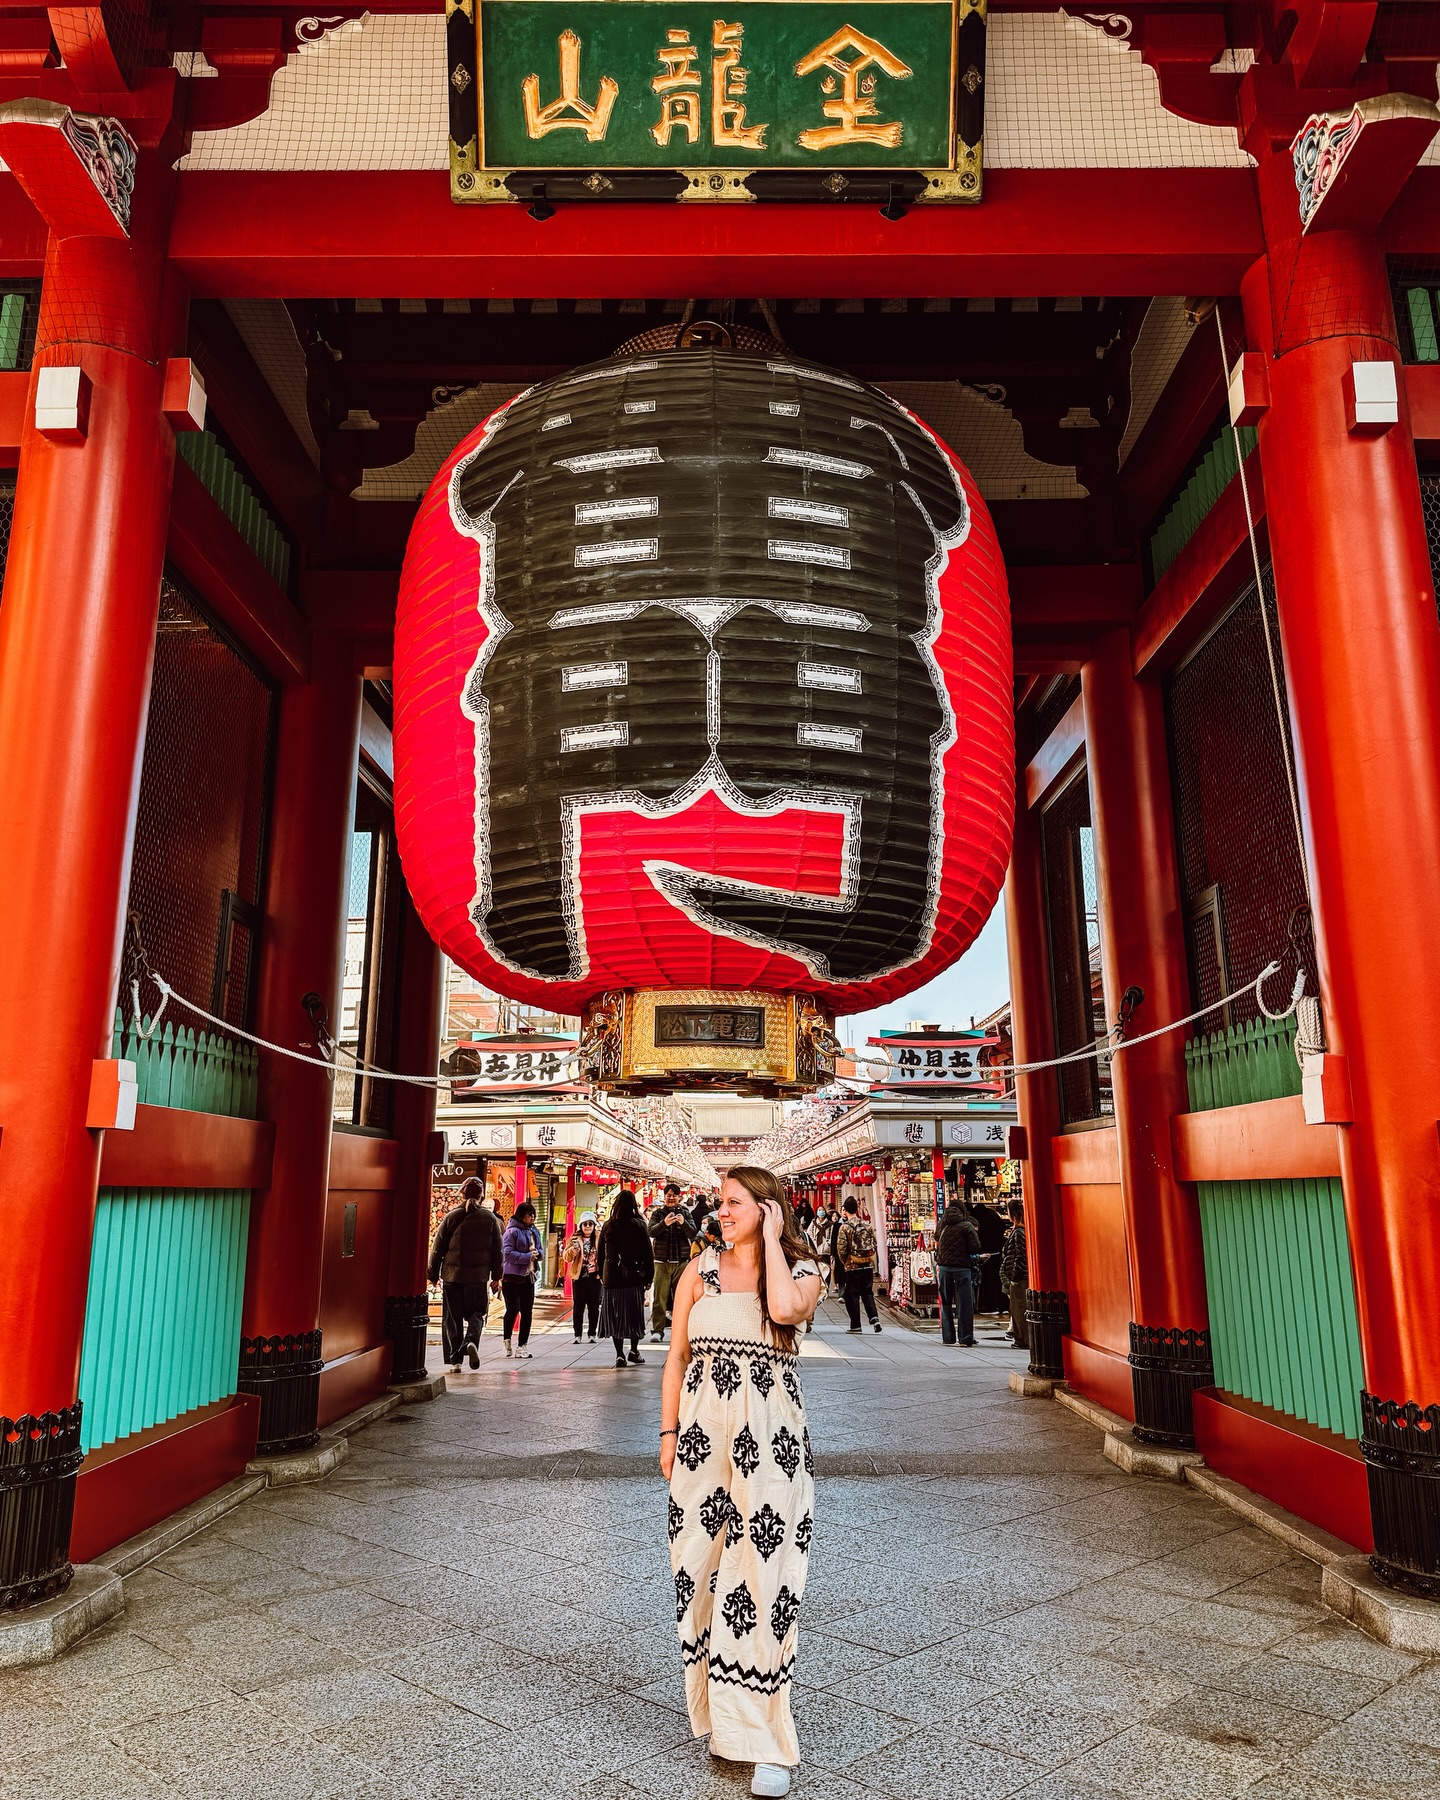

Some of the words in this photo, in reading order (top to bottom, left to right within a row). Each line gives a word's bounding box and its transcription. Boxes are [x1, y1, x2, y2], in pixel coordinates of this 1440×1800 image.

[662, 1013, 760, 1039] 松下電器
[461, 1129, 479, 1146] 浅
[986, 1125, 1004, 1141] 浅
